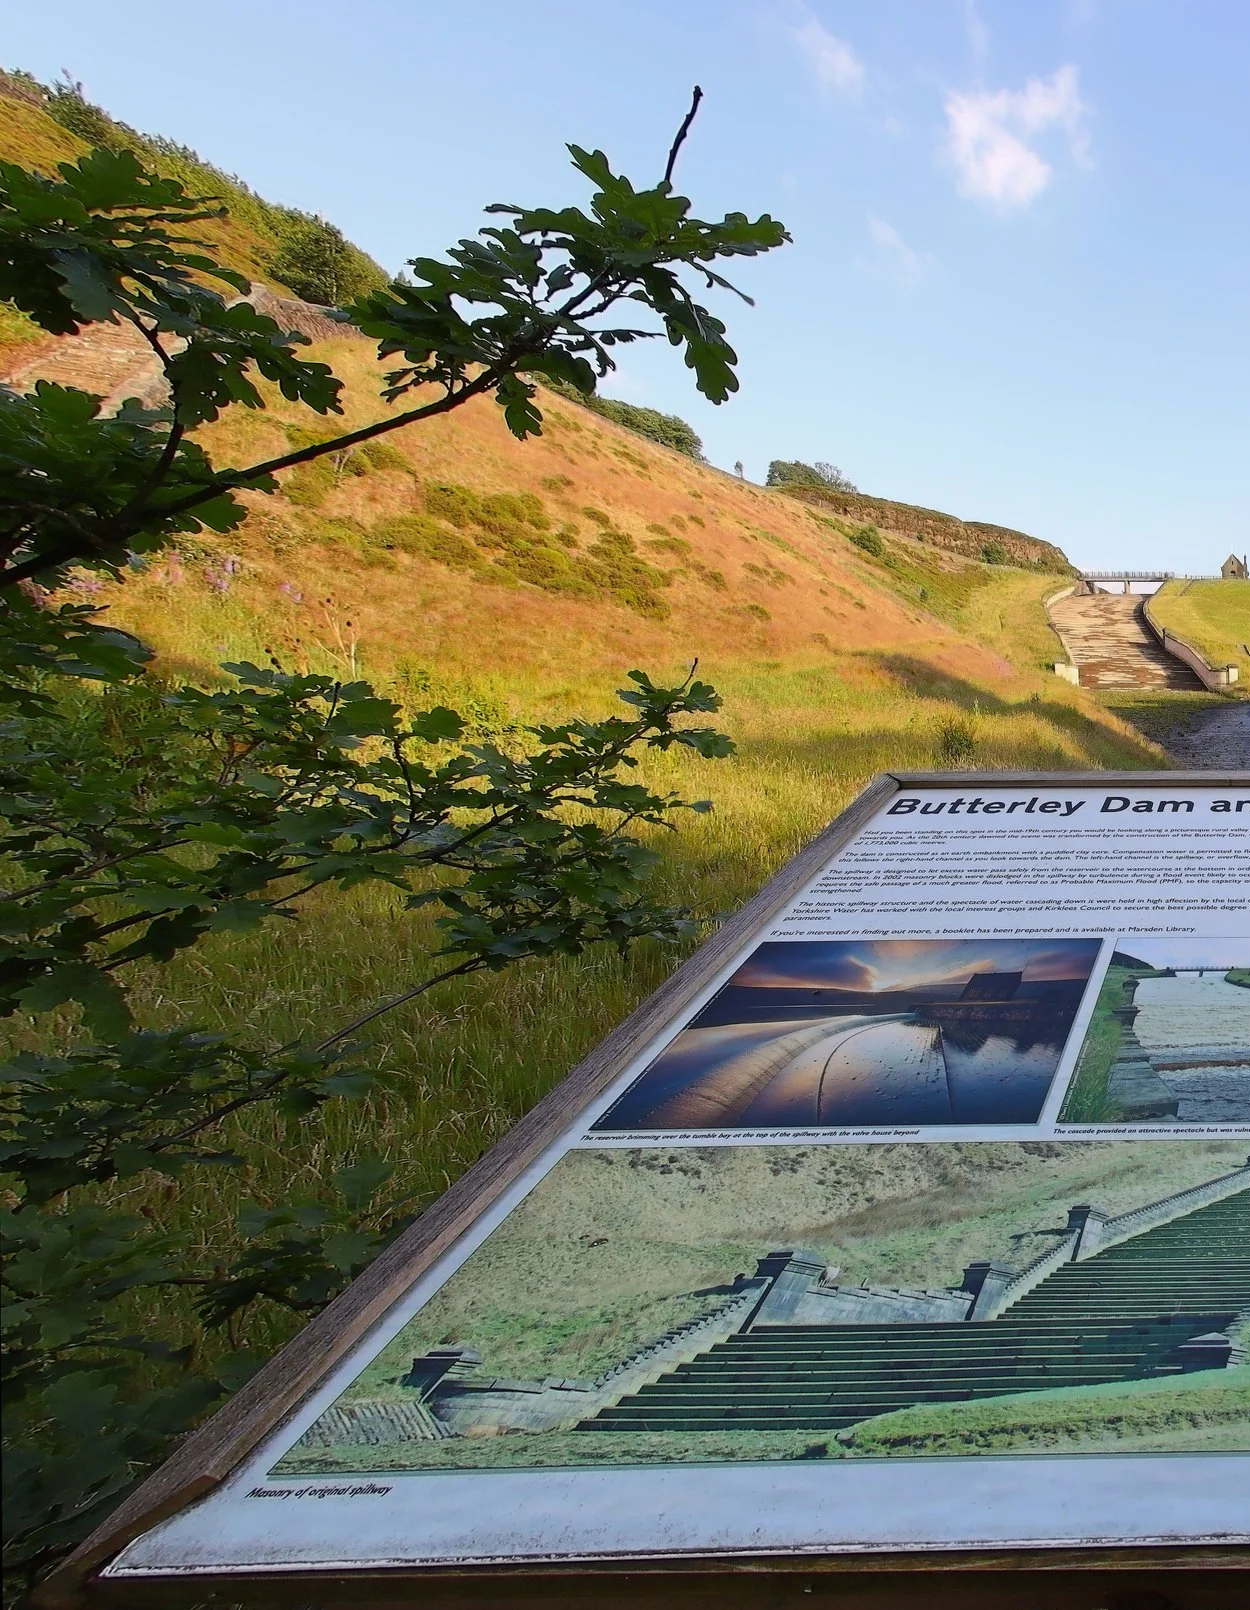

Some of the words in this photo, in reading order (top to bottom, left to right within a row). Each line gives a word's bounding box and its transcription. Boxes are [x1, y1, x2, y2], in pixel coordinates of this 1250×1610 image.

[886, 797, 1086, 816] Butterley
[1100, 796, 1194, 813] Dam
[861, 928, 890, 936] finding
[1014, 927, 1054, 935] prepared
[244, 1487, 295, 1500] Masonry
[295, 1486, 313, 1499] of
[308, 1485, 351, 1499] original
[350, 1483, 393, 1497] spillway
